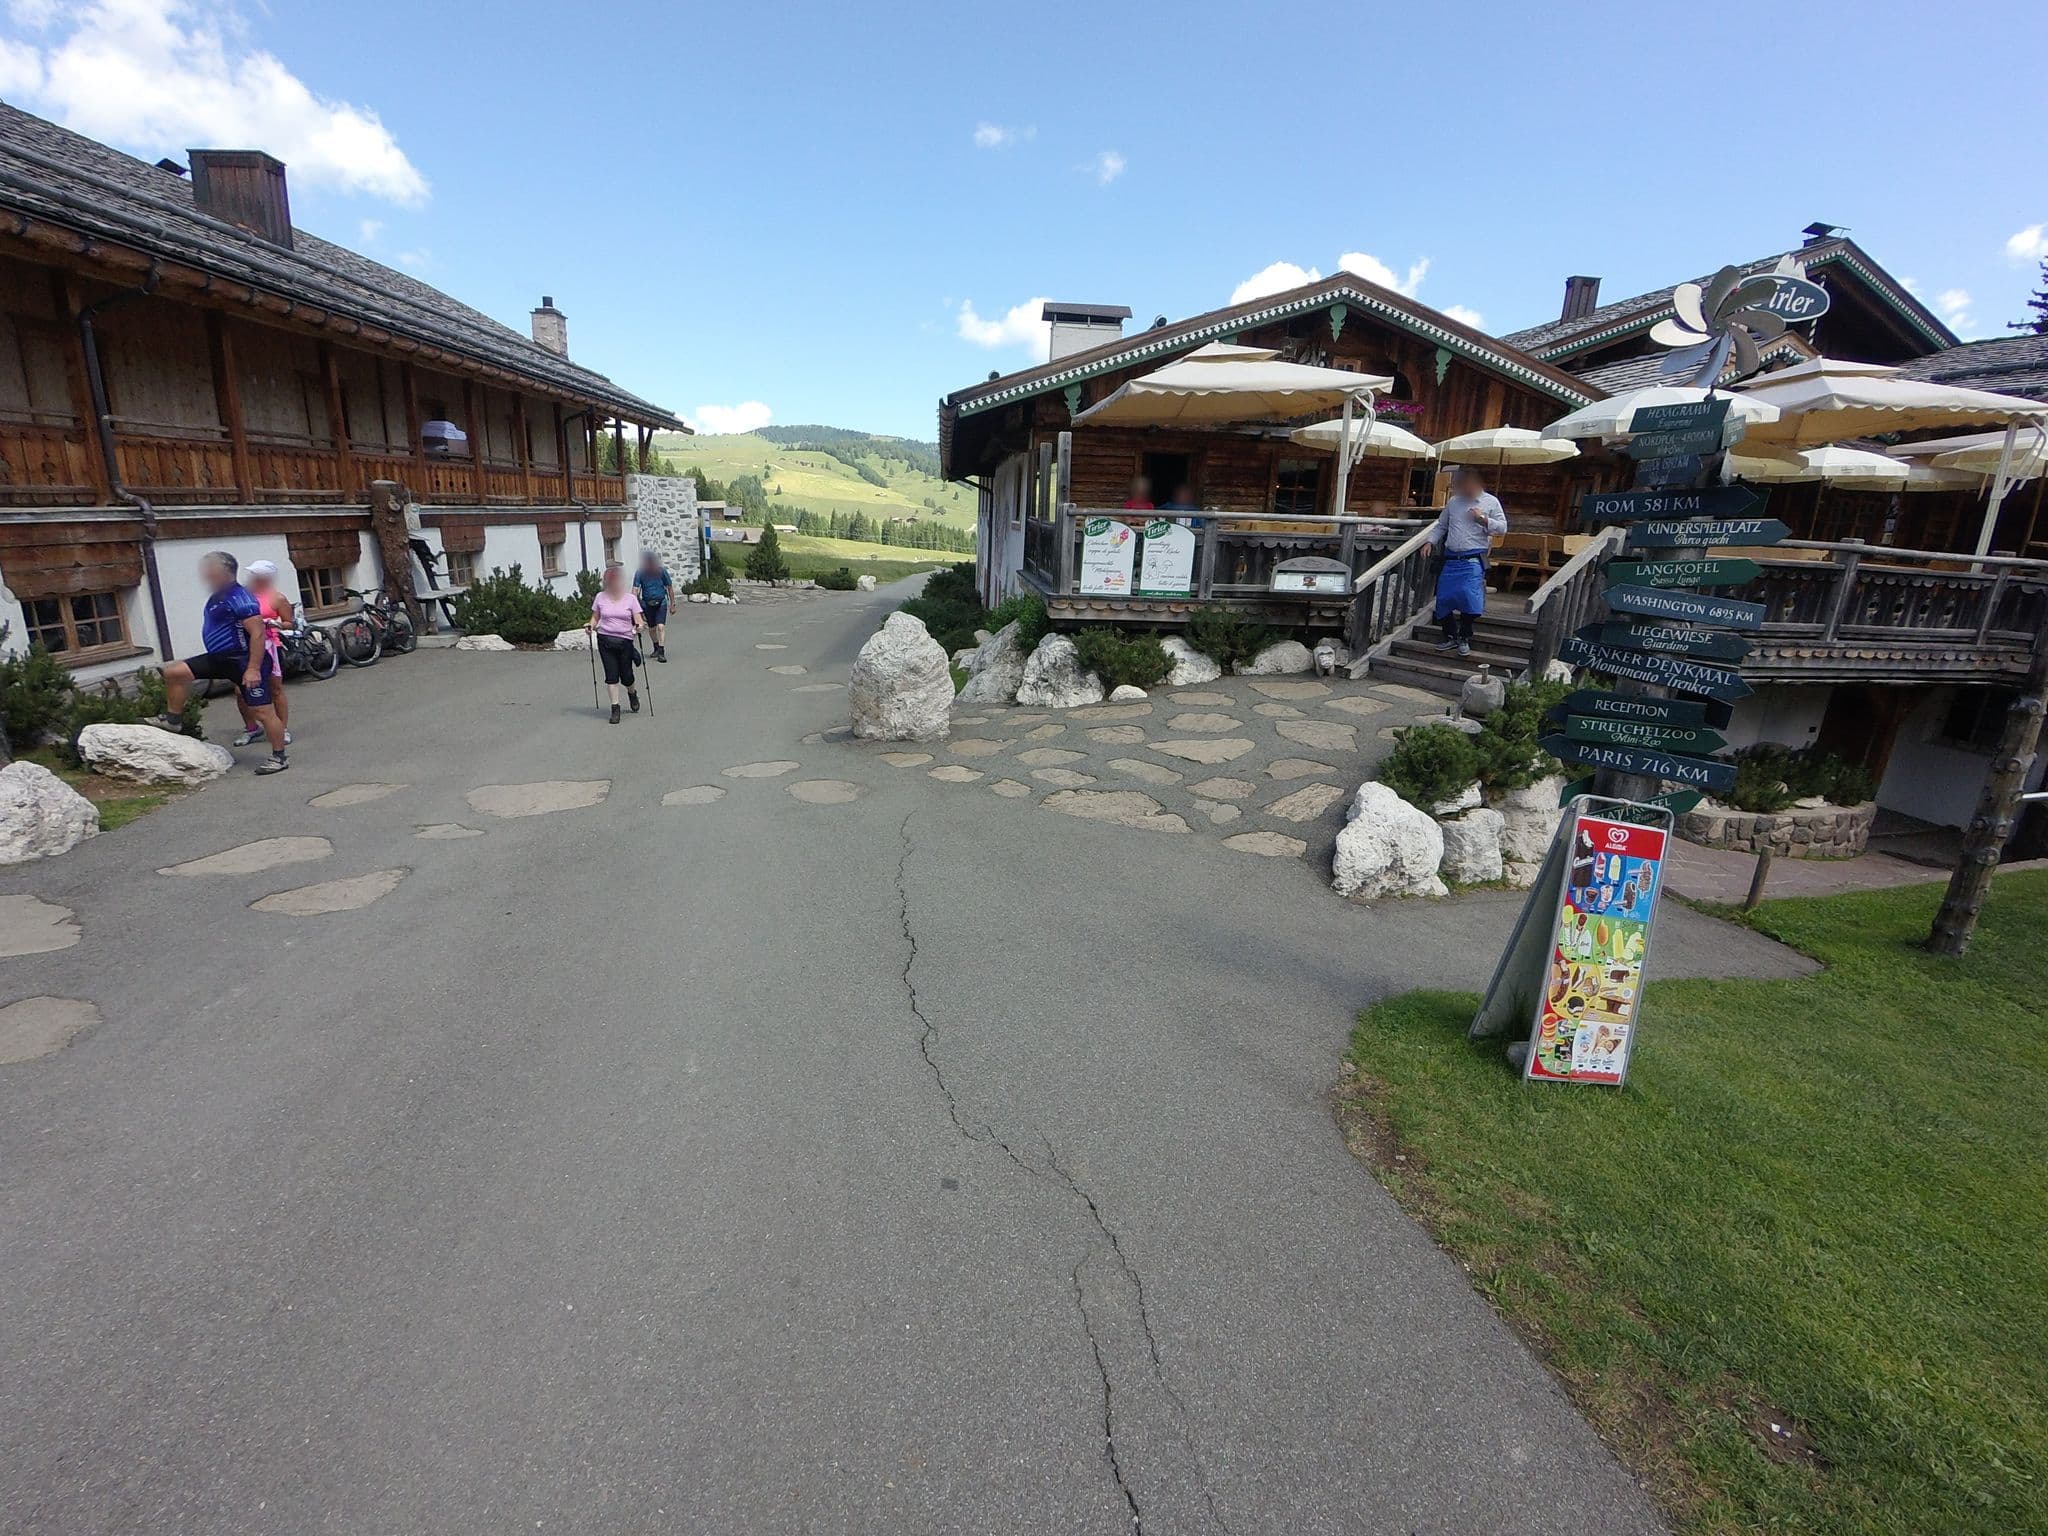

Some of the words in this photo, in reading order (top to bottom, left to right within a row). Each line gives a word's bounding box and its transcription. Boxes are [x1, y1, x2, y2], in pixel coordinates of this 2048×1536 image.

[1647, 403, 1712, 418] HEXAGRAMM
[1595, 499, 1635, 514] ROM
[1642, 498, 1668, 512] 581
[1673, 496, 1700, 511] KM
[1647, 521, 1762, 535] KINDERSPIELPLATZ
[1674, 533, 1701, 545] Parco
[1702, 532, 1730, 546] giochi
[1636, 562, 1720, 576] LANGKOFEL
[1622, 593, 1706, 616] WASHINGTON
[1709, 606, 1734, 620] 6895
[1735, 610, 1753, 622] KM
[1630, 625, 1714, 645] LIEGEWIESE
[1642, 637, 1690, 652] Giardino
[1568, 639, 1642, 666] TRENKER
[1646, 657, 1733, 686] DENKMAL
[1576, 656, 1660, 684] Monumento
[1664, 672, 1715, 696] Trenker
[1594, 699, 1669, 718] RECEPTION
[1580, 719, 1697, 741] STREICHELZOO
[1610, 733, 1662, 747] Mini-Zoo
[1578, 745, 1634, 767] PARIS
[1641, 757, 1670, 775] 716
[1676, 764, 1710, 783] KM
